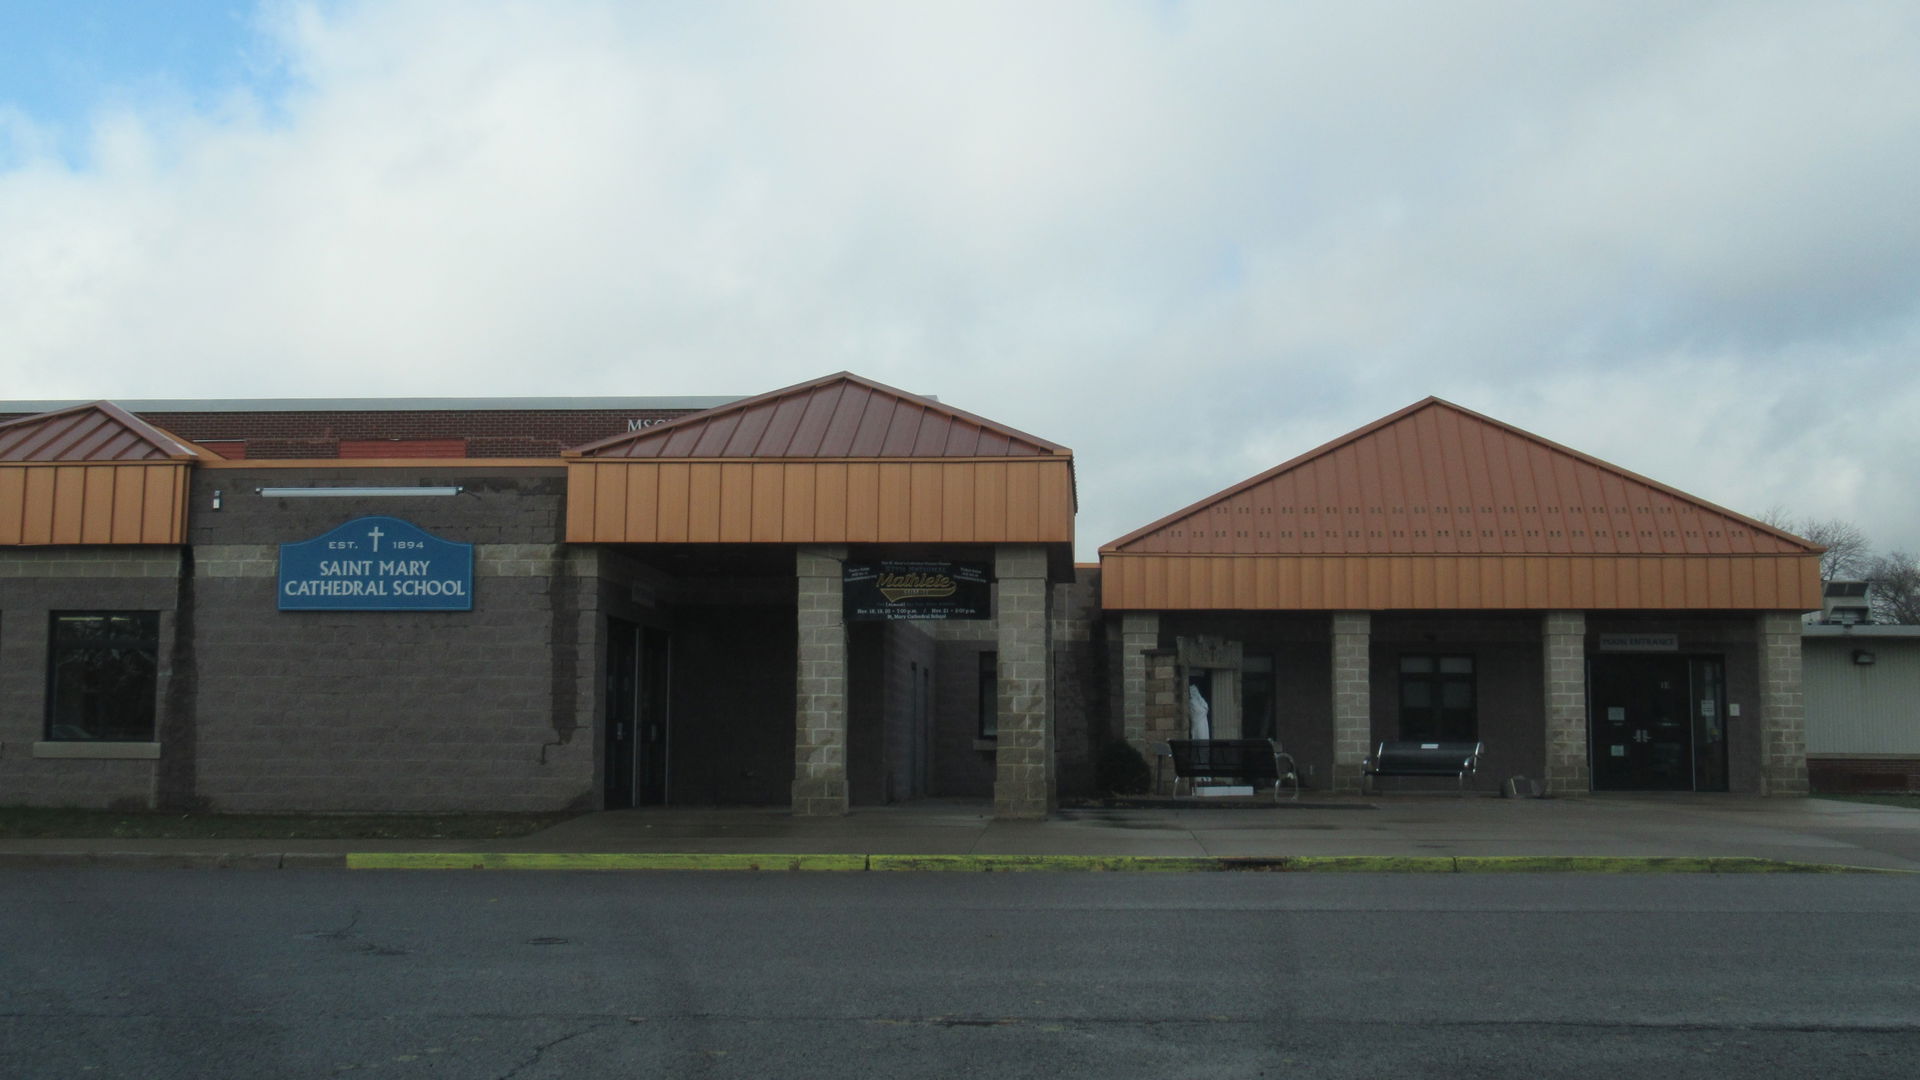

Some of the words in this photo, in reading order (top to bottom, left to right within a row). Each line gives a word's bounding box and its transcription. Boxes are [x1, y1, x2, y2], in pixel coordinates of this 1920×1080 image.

[328, 541, 358, 550] EST.
[393, 541, 424, 550] 1894
[319, 560, 373, 576] SAINT
[379, 560, 430, 576] MARY
[284, 580, 389, 596] CATHEDRAL
[393, 580, 466, 596] SCHOOL
